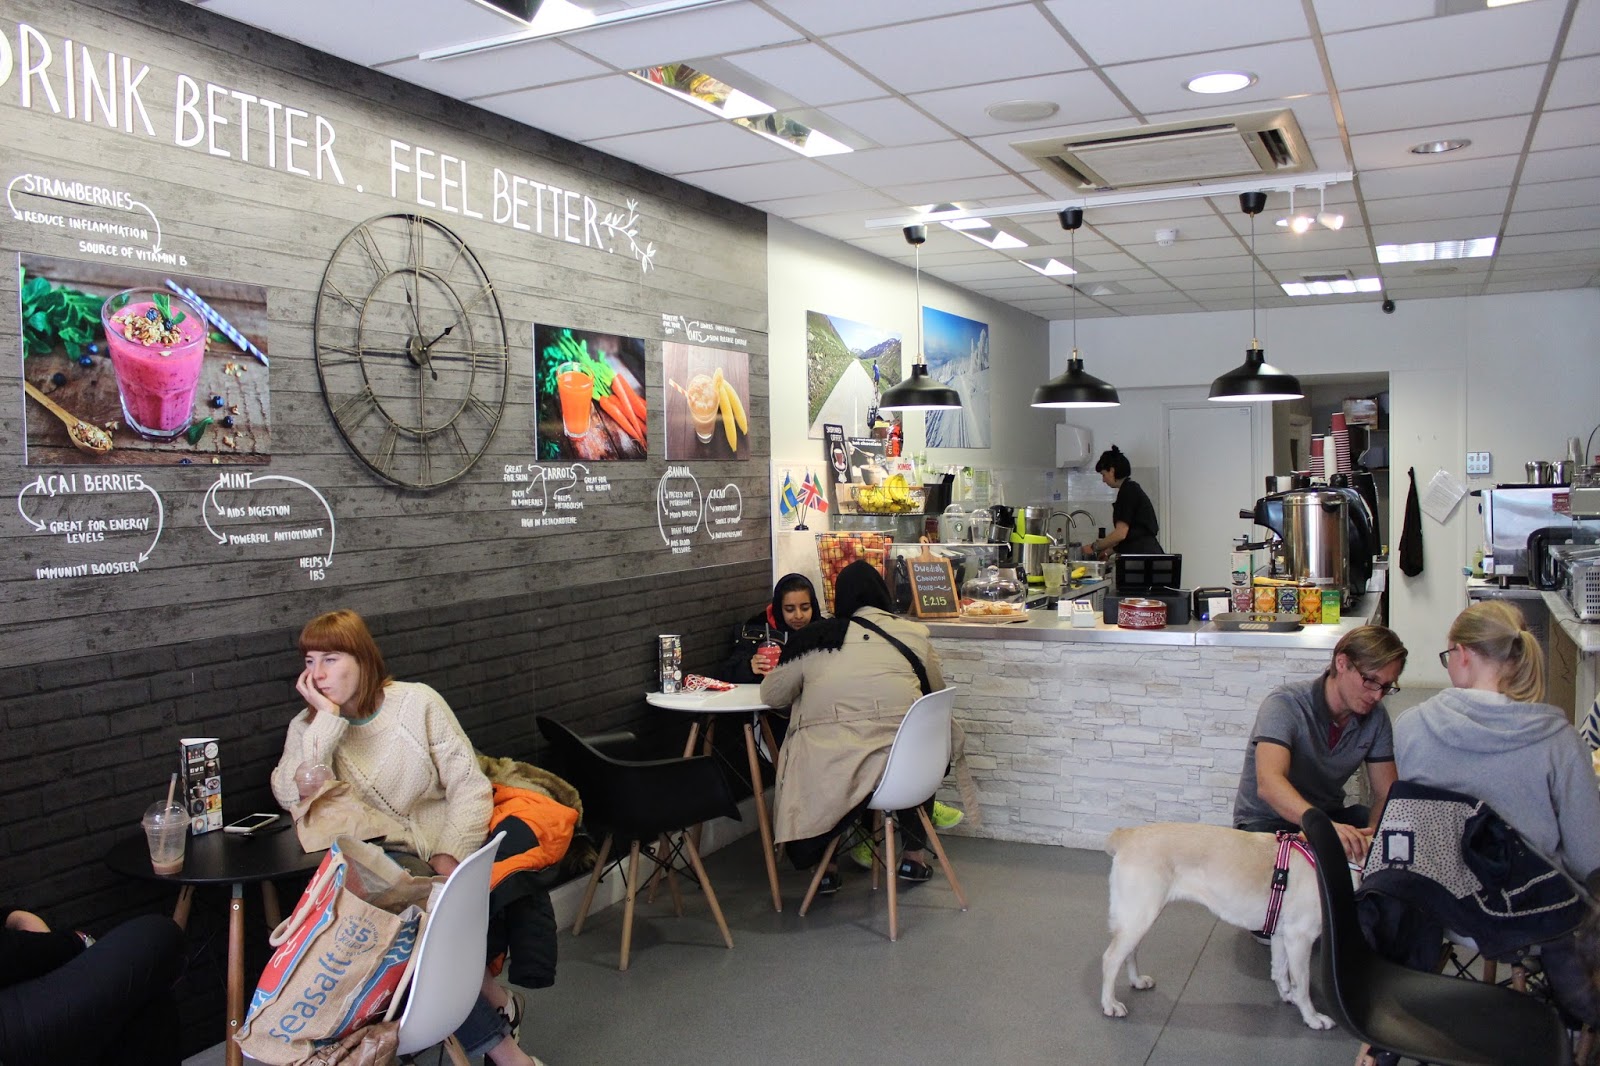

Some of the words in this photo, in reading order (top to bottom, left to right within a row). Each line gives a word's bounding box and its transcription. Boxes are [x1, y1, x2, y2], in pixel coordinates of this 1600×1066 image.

[390, 139, 483, 219] FEEL
[24, 173, 134, 210] STRAWBERRIES
[24, 211, 65, 227] REDUCE
[69, 218, 148, 240] INFLAMMATION
[79, 240, 118, 257] SOURCE
[121, 246, 134, 259] OF
[136, 249, 176, 265] VITAMIN
[179, 256, 188, 266] B
[688, 330, 702, 341] OATS
[504, 464, 523, 474] GREAT
[541, 467, 576, 480] CARROTS
[668, 466, 690, 478] BANANA
[219, 472, 253, 489] MINT
[503, 474, 515, 482] FOR
[515, 473, 528, 482] SKIN
[584, 476, 597, 485] GREAT
[35, 474, 77, 497] AÇAI
[83, 474, 145, 492] BERRIES
[512, 490, 525, 498] RICH
[709, 489, 726, 499] CACAO
[518, 498, 543, 506] MINERALS
[226, 507, 246, 518] AIDS
[248, 505, 290, 517] DIGESTION
[49, 520, 83, 534] GREAT
[88, 520, 107, 531] FOR
[109, 518, 149, 531] ENERGY
[66, 532, 104, 544] LEVELS
[229, 533, 270, 545] POWERFUL
[274, 527, 324, 541] ANTIOXIDANT
[299, 557, 323, 568] HELPS
[36, 564, 87, 579] IMMUNITY
[91, 561, 139, 575] BOOSTER
[309, 569, 325, 581] IBS
[344, 921, 371, 943] 35
[268, 952, 352, 1044] seasalt
